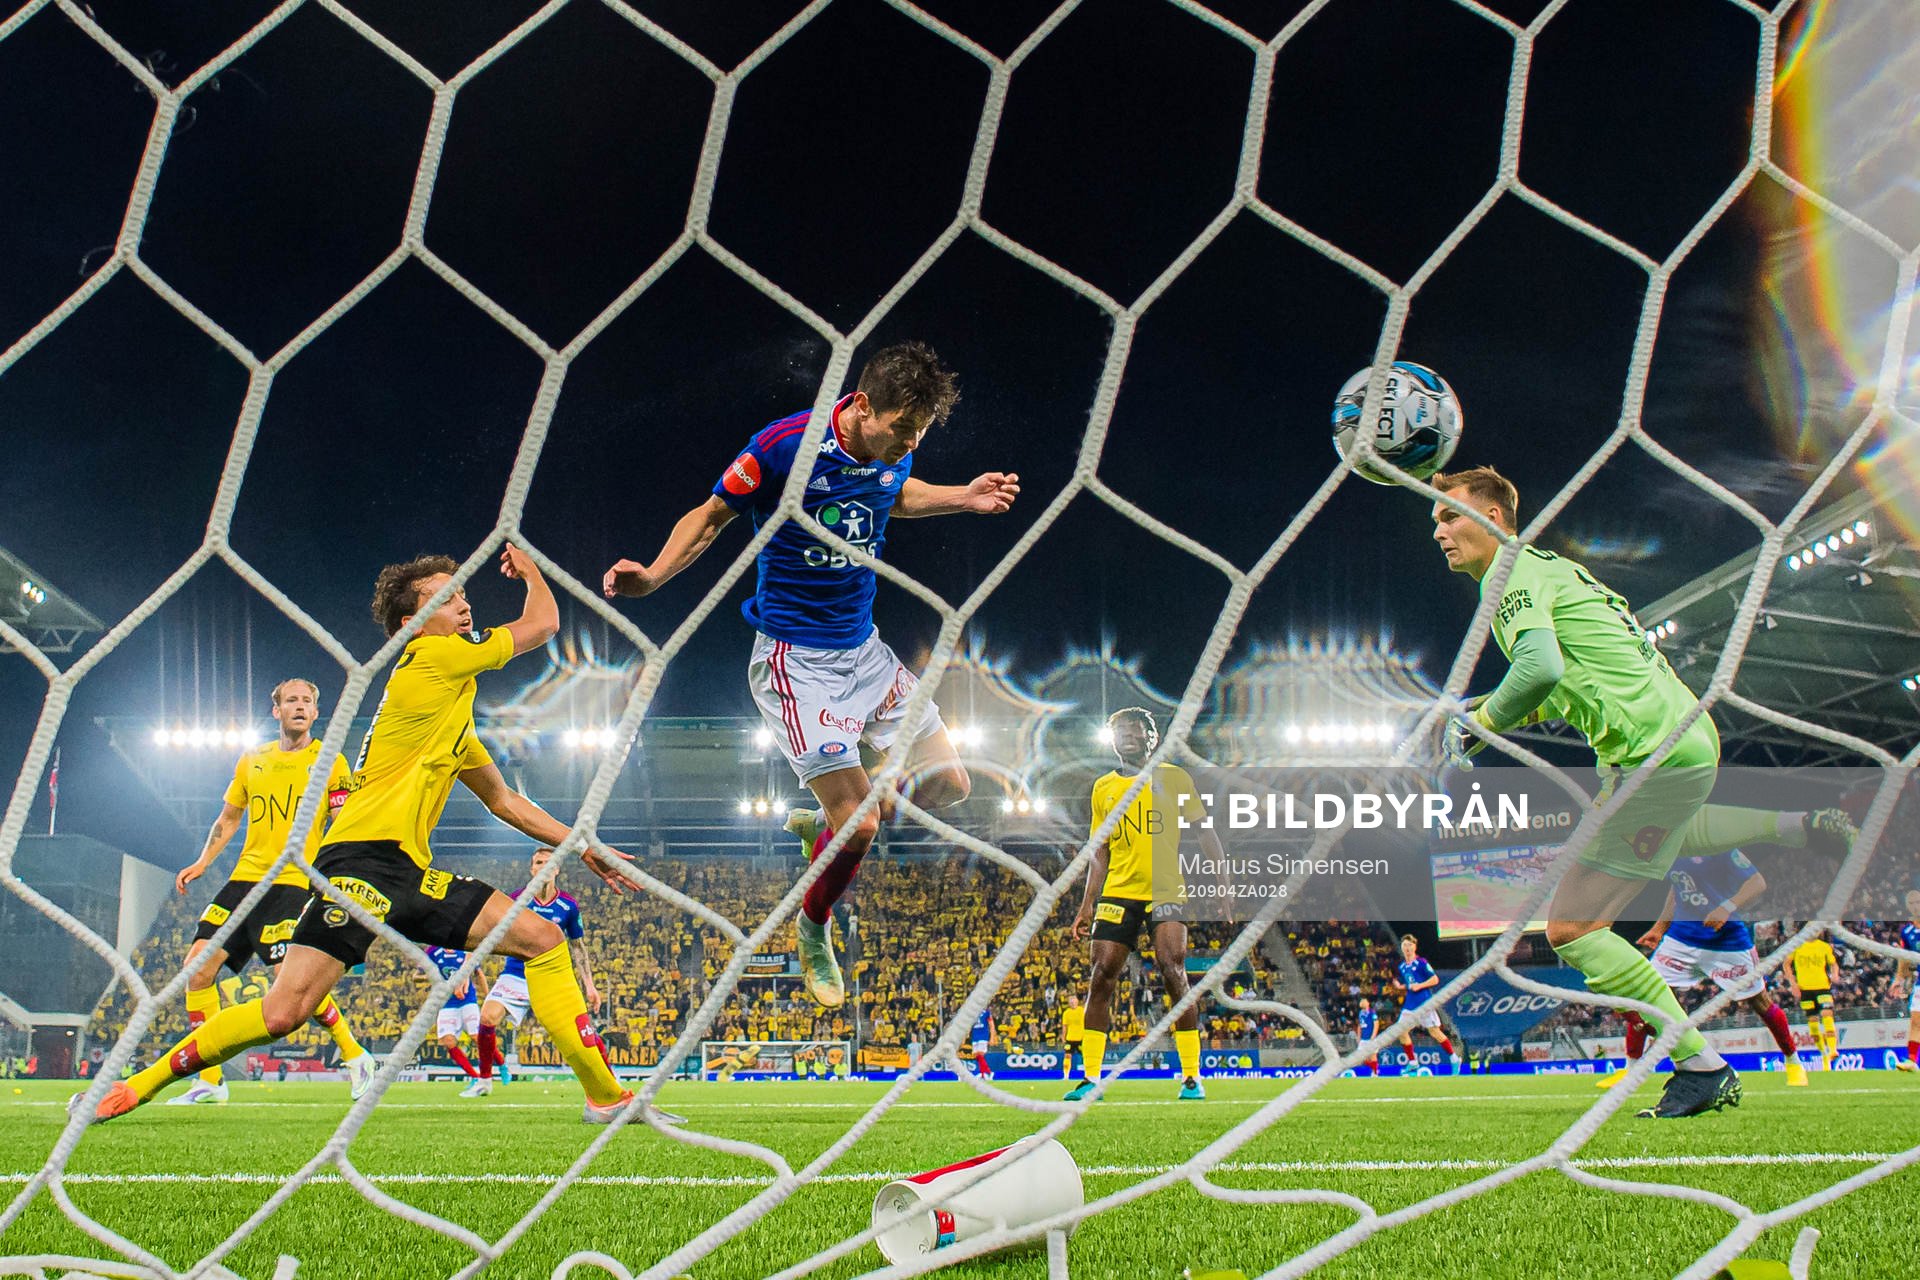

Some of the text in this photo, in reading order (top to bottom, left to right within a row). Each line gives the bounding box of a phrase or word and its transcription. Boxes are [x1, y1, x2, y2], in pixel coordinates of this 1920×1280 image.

[804, 542, 878, 568] OBS
[1497, 590, 1530, 614] EATIVE
[251, 784, 303, 831] DN
[334, 880, 388, 913] AKRENE
[270, 943, 286, 959] 23
[1493, 995, 1562, 1014] OBOS
[1006, 1054, 1058, 1070] coop
[1397, 1053, 1442, 1065] OOS
